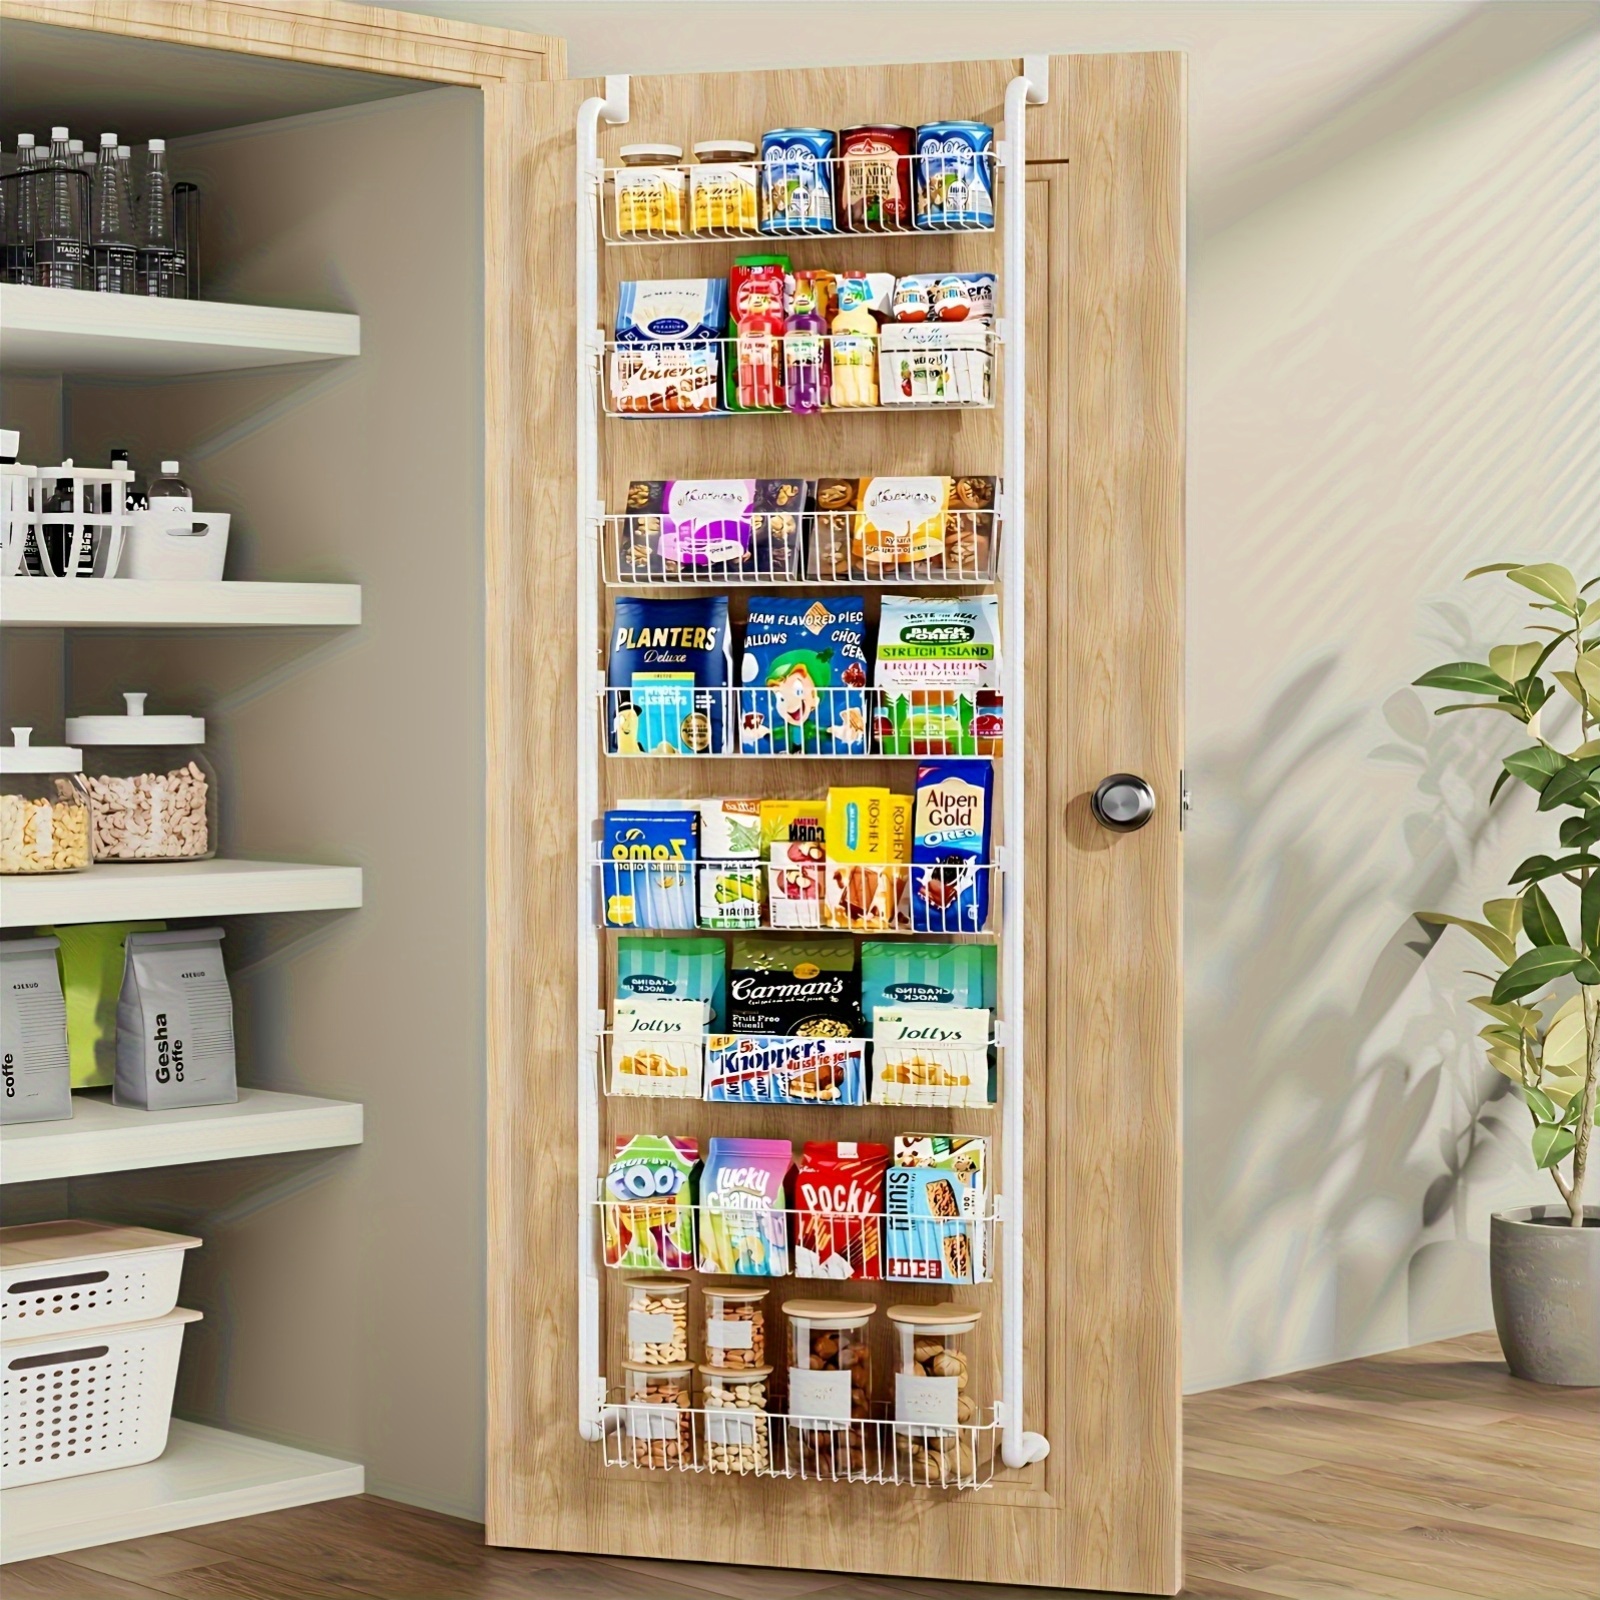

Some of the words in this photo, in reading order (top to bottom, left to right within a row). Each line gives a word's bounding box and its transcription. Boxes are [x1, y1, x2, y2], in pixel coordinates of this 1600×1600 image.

[748, 613, 775, 624] HAM
[778, 614, 836, 626] FLAVORED
[838, 611, 864, 623] PIEC
[903, 612, 936, 620] TASTE
[615, 626, 716, 652] PLANTERS
[905, 632, 970, 640] FOREST
[911, 627, 966, 635] BLACK
[643, 649, 687, 663] Deluxe
[926, 789, 978, 813] Alpen
[869, 798, 881, 853] ROSHEN
[929, 808, 972, 827] Gold
[893, 805, 905, 860] ROSHEN
[924, 828, 977, 848] OREO
[731, 977, 844, 1001] Carman's
[630, 1018, 682, 1033] Jollys
[732, 1014, 756, 1022] Fruit
[897, 1026, 963, 1041] Jollys
[154, 1013, 171, 1084] Gesha
[720, 1040, 826, 1075] Knoppers
[172, 1039, 185, 1082] coffe
[1, 1053, 16, 1098] coffe
[609, 1157, 650, 1174] FRUIT
[889, 1171, 910, 1231] minis
